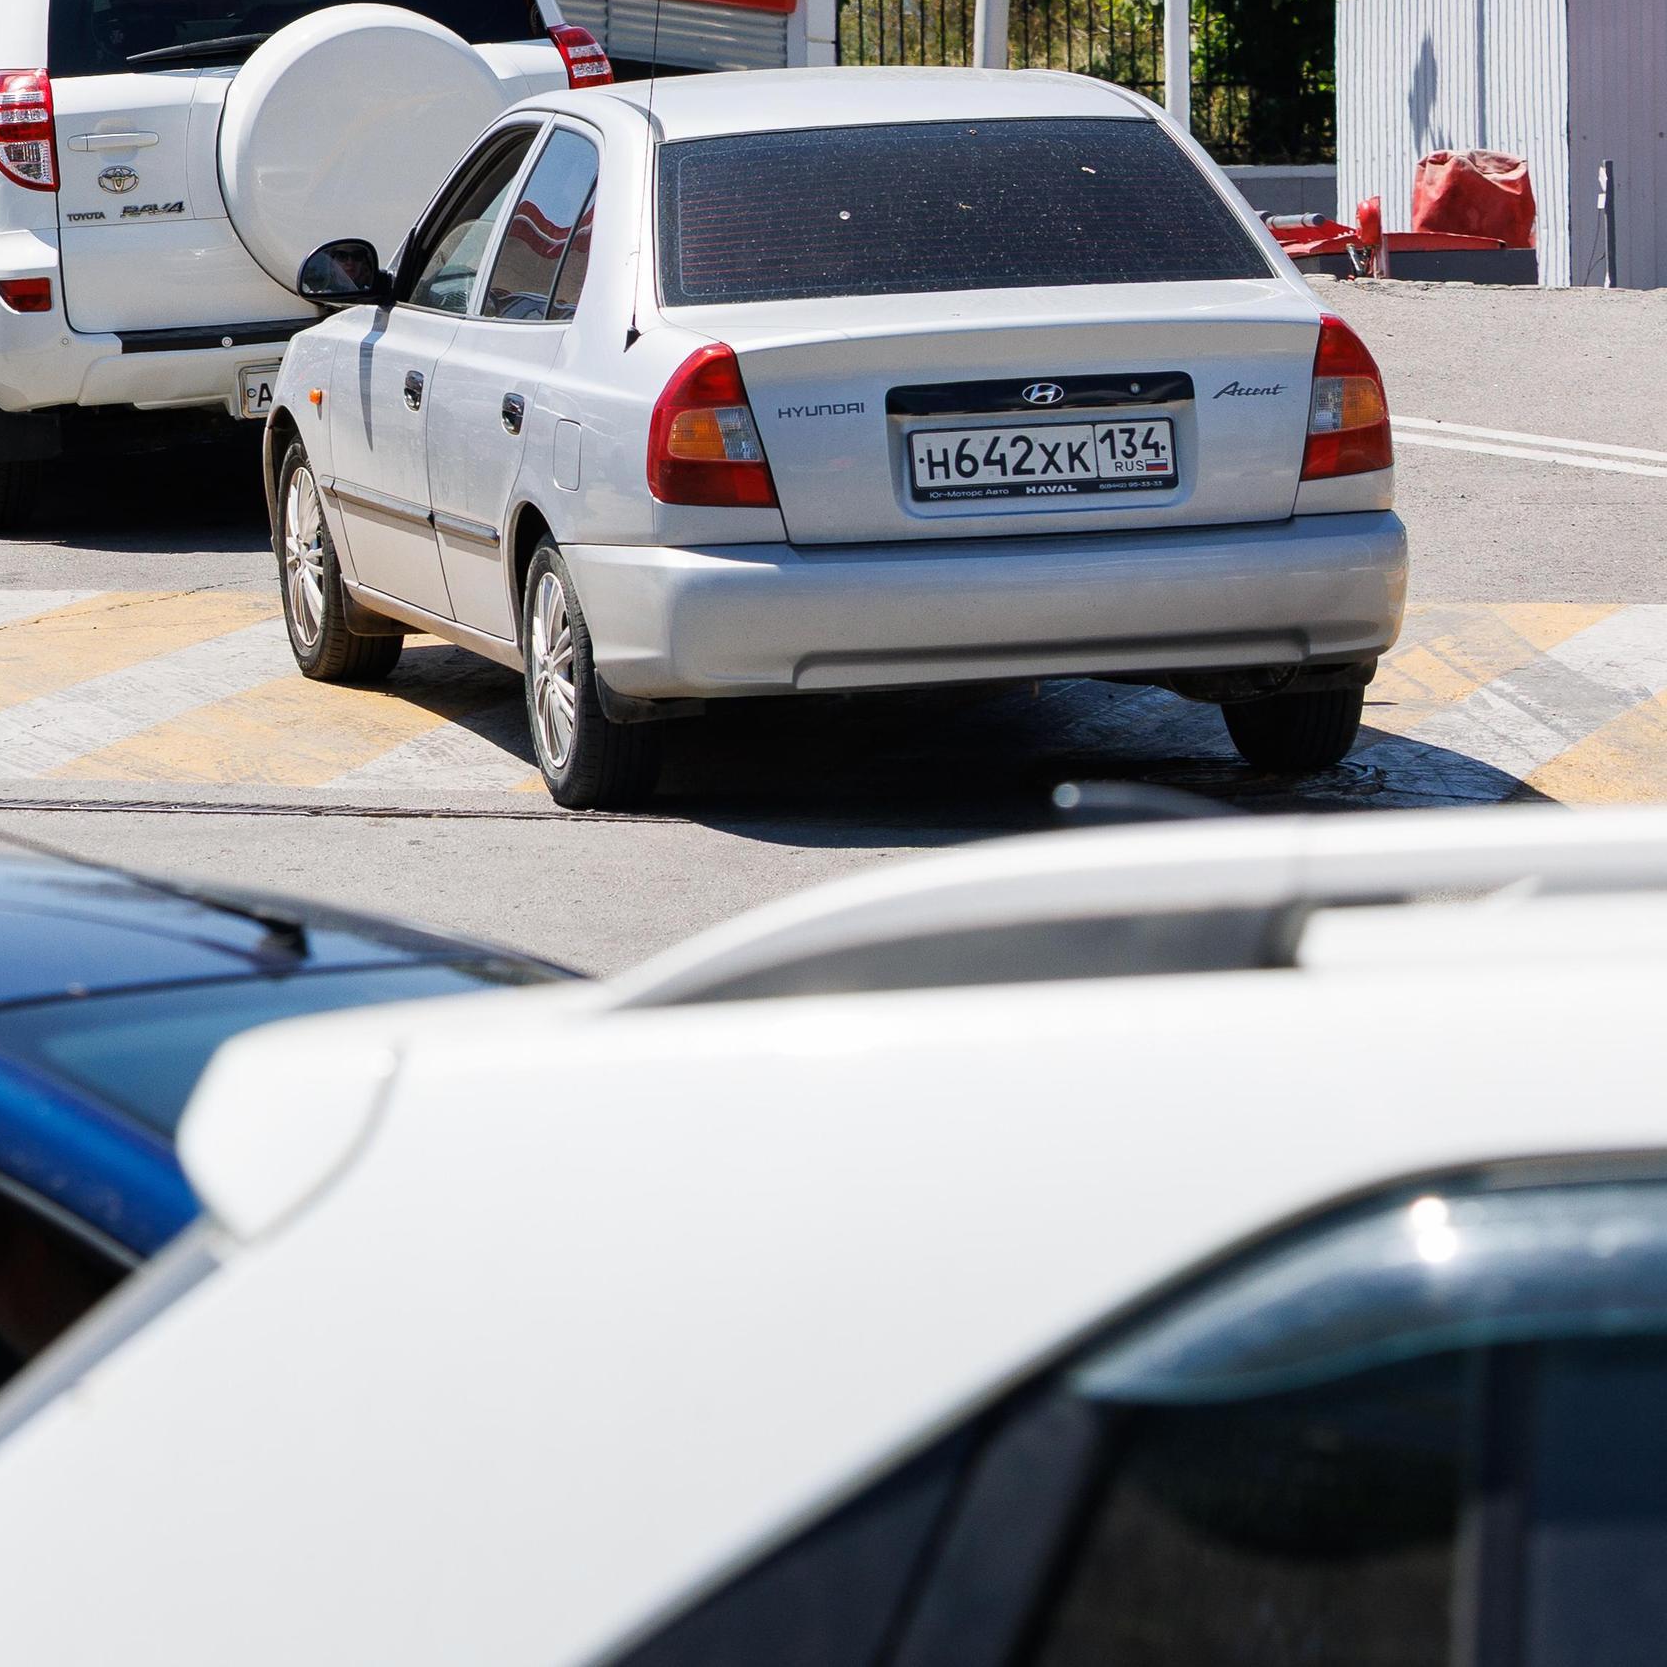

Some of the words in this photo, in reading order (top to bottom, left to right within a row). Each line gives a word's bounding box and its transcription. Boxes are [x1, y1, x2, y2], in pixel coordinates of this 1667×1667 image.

[67, 211, 106, 222] TOYOTA
[120, 200, 185, 218] RAV4
[1212, 380, 1288, 399] Accent
[777, 402, 865, 419] HYUNDAI
[926, 434, 1091, 480] Н642ХК
[1098, 426, 1160, 460] 134
[1114, 460, 1145, 472] RUS
[1026, 484, 1078, 494] HAVAL
